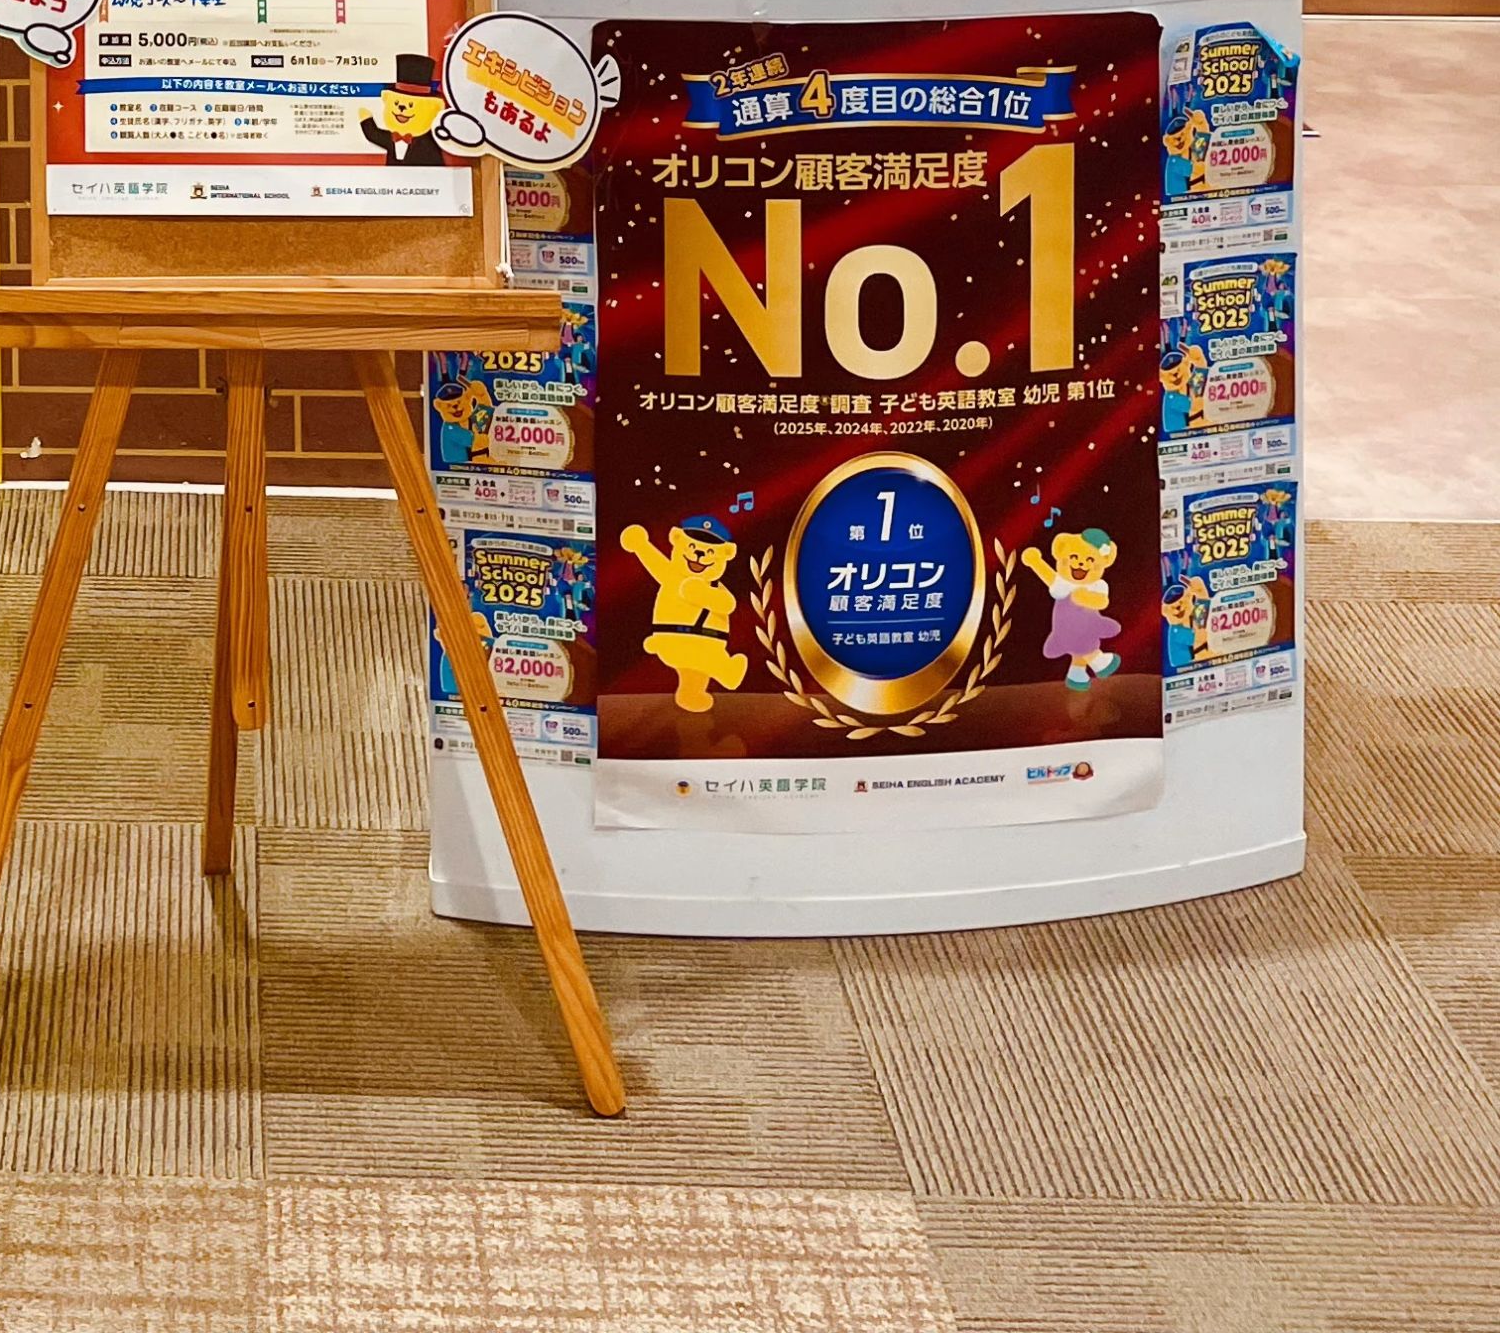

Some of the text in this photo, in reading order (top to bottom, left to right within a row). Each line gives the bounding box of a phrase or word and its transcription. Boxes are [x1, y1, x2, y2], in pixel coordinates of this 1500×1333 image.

[1200, 44, 1258, 61] Summer
[711, 55, 788, 96] 2年連続
[1202, 57, 1255, 76] School
[161, 78, 361, 96] 以下の内容を教室メールへお送りください
[462, 39, 587, 126] エキシビション
[1203, 76, 1252, 98] 2025
[484, 90, 552, 144] もあるよ
[652, 150, 988, 192] オリコン顧客満足度
[71, 181, 169, 196] セイハ英語学院
[325, 188, 440, 196] SEIHA ENGLISH ACADEMY
[663, 142, 1076, 381] No.1
[1192, 278, 1256, 297] Summer
[1198, 292, 1250, 311] School
[1200, 309, 1250, 333] 2025
[483, 351, 542, 372] 2025
[879, 379, 1115, 414] 子ども英語教室 幼児 第1位
[1192, 507, 1256, 527] Summer
[1198, 523, 1252, 543] School
[475, 550, 549, 570] Summer
[1200, 540, 1250, 563] 2025
[481, 566, 545, 587] School
[827, 562, 946, 591] オリコン
[484, 584, 543, 606] 2025
[828, 592, 945, 612] 顧客満足度
[832, 629, 942, 646] 子ども英語教室 幼児
[704, 776, 828, 794] セイハ英語学院
[872, 774, 1006, 790] SEIHA ENGLISH ACADEMY
